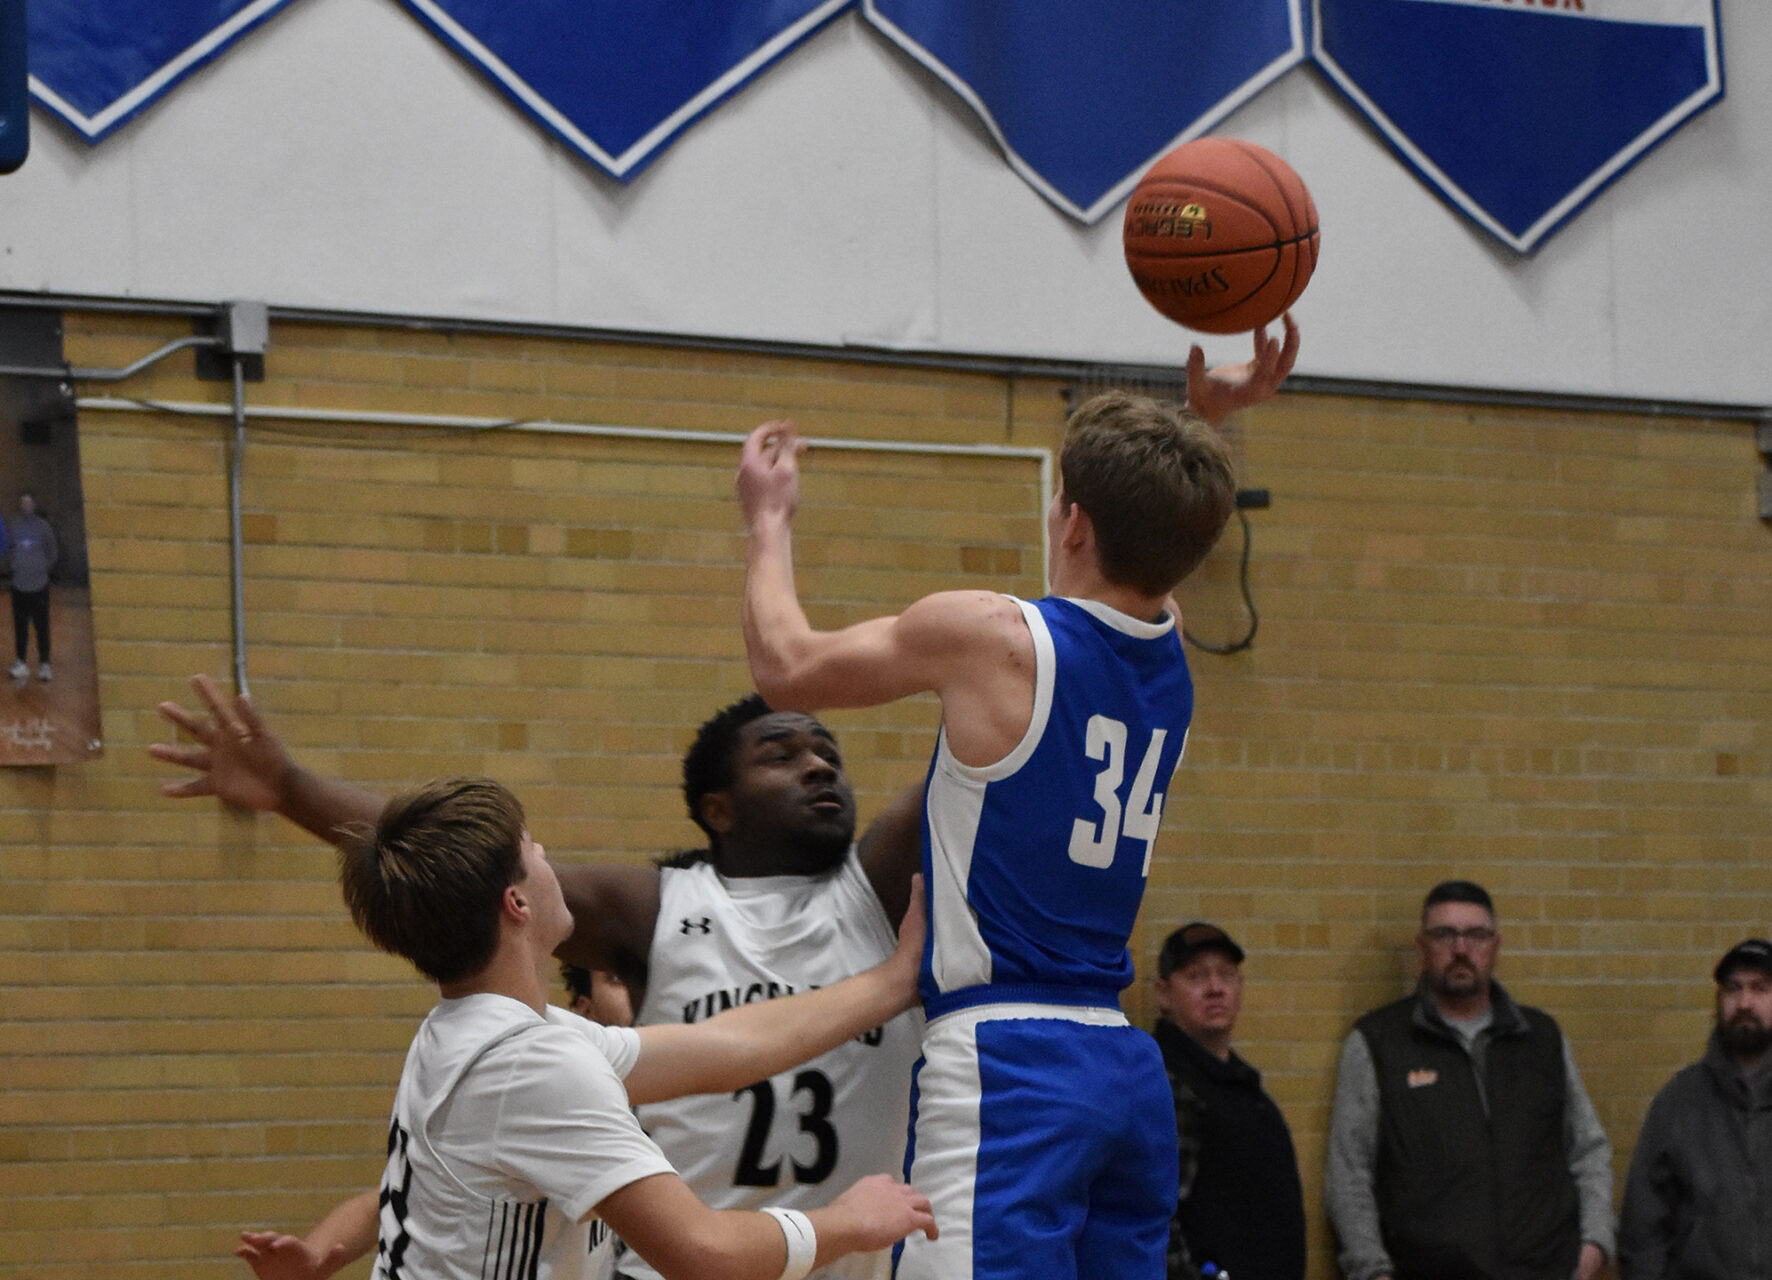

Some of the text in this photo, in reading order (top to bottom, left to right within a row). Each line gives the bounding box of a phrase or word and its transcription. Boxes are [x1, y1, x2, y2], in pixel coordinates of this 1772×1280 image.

[1133, 266, 1230, 297] SPAL
[1068, 713, 1168, 877] 34
[732, 1067, 839, 1186] 23
